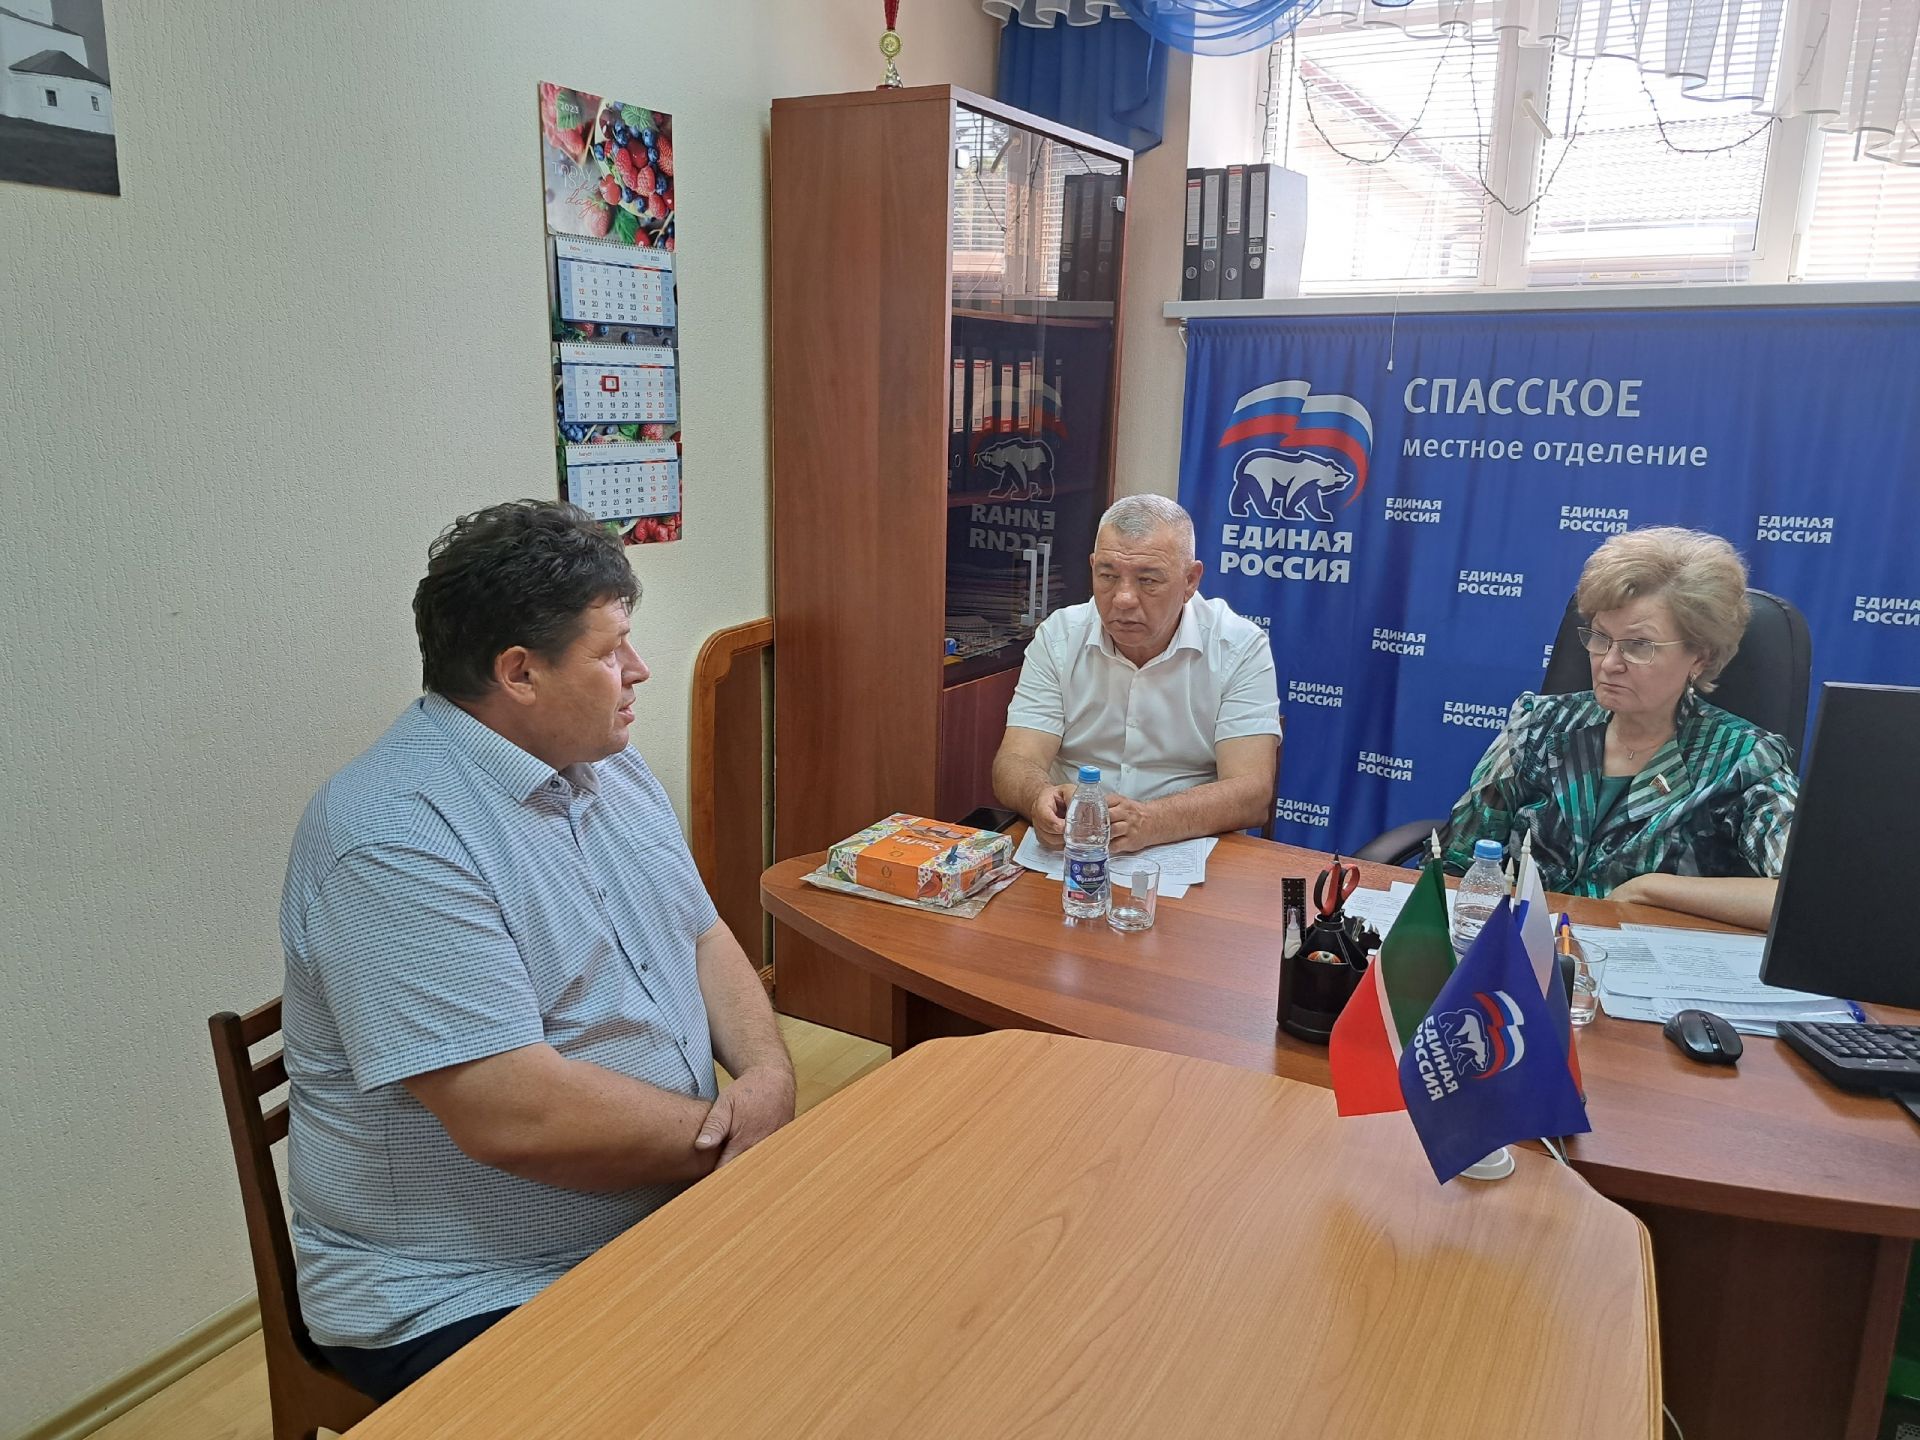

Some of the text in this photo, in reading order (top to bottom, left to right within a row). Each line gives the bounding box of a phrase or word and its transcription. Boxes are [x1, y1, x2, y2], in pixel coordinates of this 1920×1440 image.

[560, 102, 579, 114] 2023
[1403, 377, 1643, 418] СПАССКОЕ
[1402, 438, 1709, 467] местное отделение
[1386, 497, 1442, 511] ЕДИНАЯ
[1561, 505, 1629, 520] ЕДИНАЯ
[1384, 509, 1441, 523] РОССИЯ
[1758, 515, 1834, 529] ЕДИНАЯ
[1559, 518, 1628, 534] РОССИЯ
[1222, 524, 1352, 554] ЕДИНАЯ
[1757, 528, 1832, 544] РОССИЯ
[1220, 551, 1350, 584] РОССИЯ
[1459, 569, 1524, 584] ЕДИНАЯ
[1457, 582, 1522, 597] РОССИЯ
[1855, 596, 1920, 611] ЕДИНА
[1852, 609, 1920, 626] РОССИ
[1373, 627, 1426, 643] ЕДИНАЯ
[1371, 639, 1425, 656] РОССИЯ
[1289, 680, 1344, 696] ЕДИНАЯ
[1288, 691, 1342, 708] РОССИЯ
[1444, 701, 1507, 718] ЕДИНАЯ
[1443, 714, 1506, 730] РОССИЯ
[1359, 750, 1413, 769] ЕДИНАЯ
[1357, 762, 1412, 782] РОССИЯ
[1276, 798, 1330, 815] ЕДИНАЯ
[1275, 808, 1329, 827] РОССИЯ
[1414, 1022, 1444, 1101] РОССИЯ
[1424, 1015, 1459, 1094] ЕДИНАЯ
